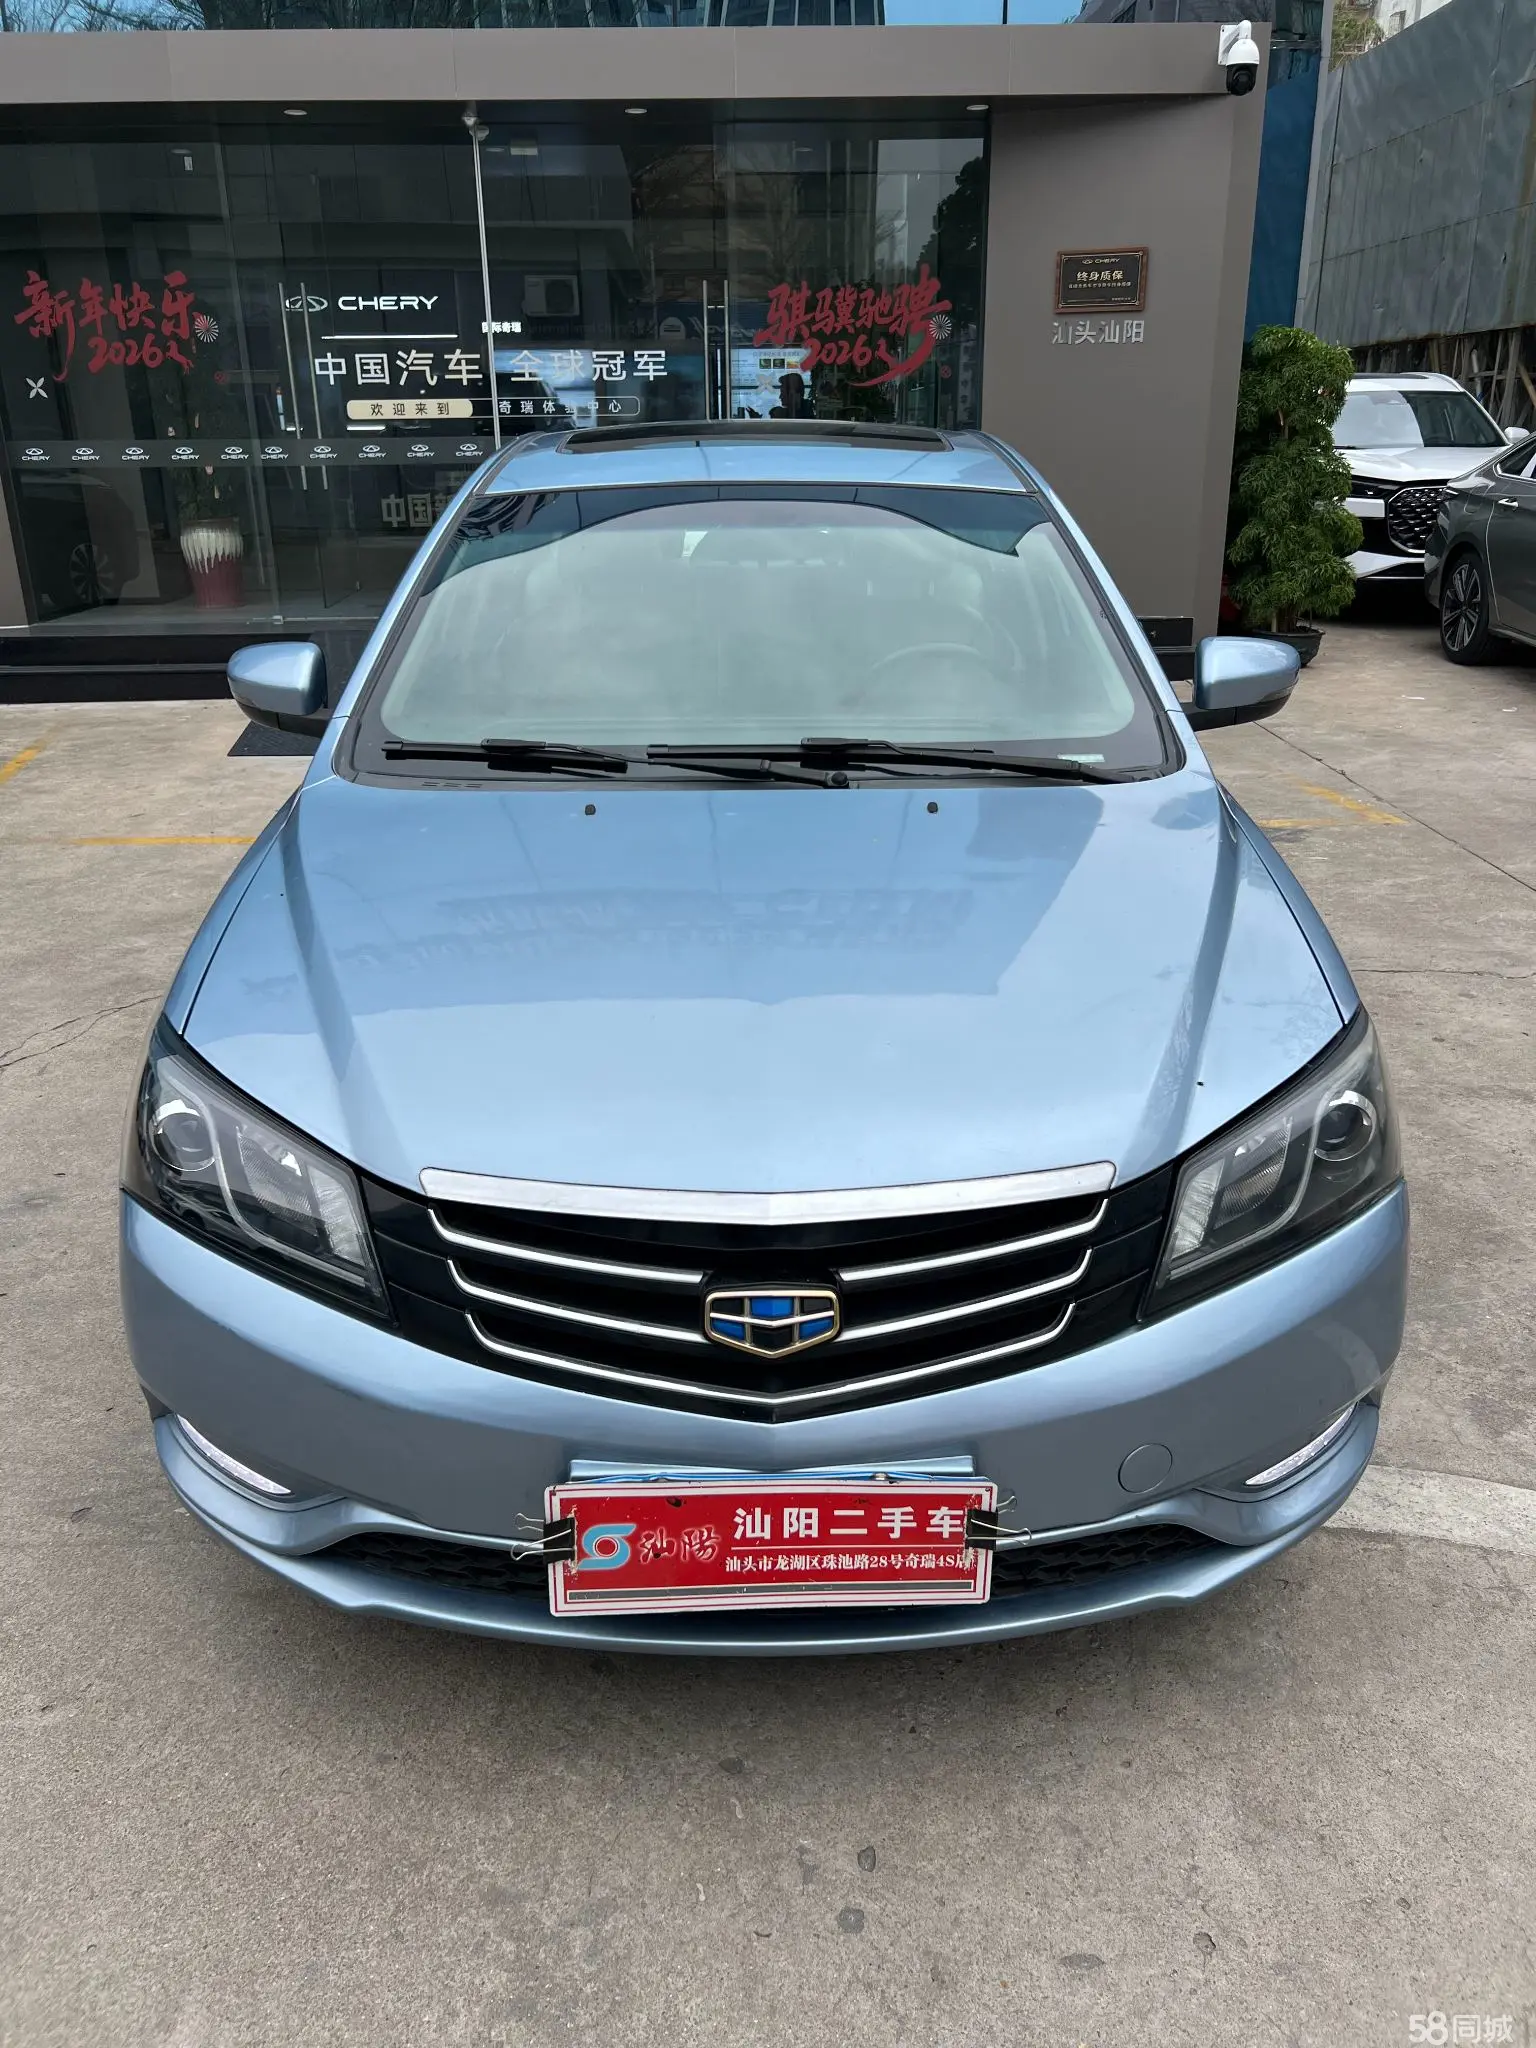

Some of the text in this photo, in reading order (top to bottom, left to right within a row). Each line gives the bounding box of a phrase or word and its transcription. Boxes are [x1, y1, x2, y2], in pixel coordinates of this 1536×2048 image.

[1076, 270, 1123, 282] 终身质保
[338, 296, 439, 310] CHERY
[14, 270, 209, 382] 新年快乐
[1052, 320, 1145, 345] 汕头汕阳
[88, 333, 163, 374] 2026
[314, 349, 668, 386] 中国汽车 全球冠军
[801, 334, 873, 372] 2026
[370, 402, 450, 417] 欢迎来到
[733, 1506, 964, 1541] 汕阳二手车
